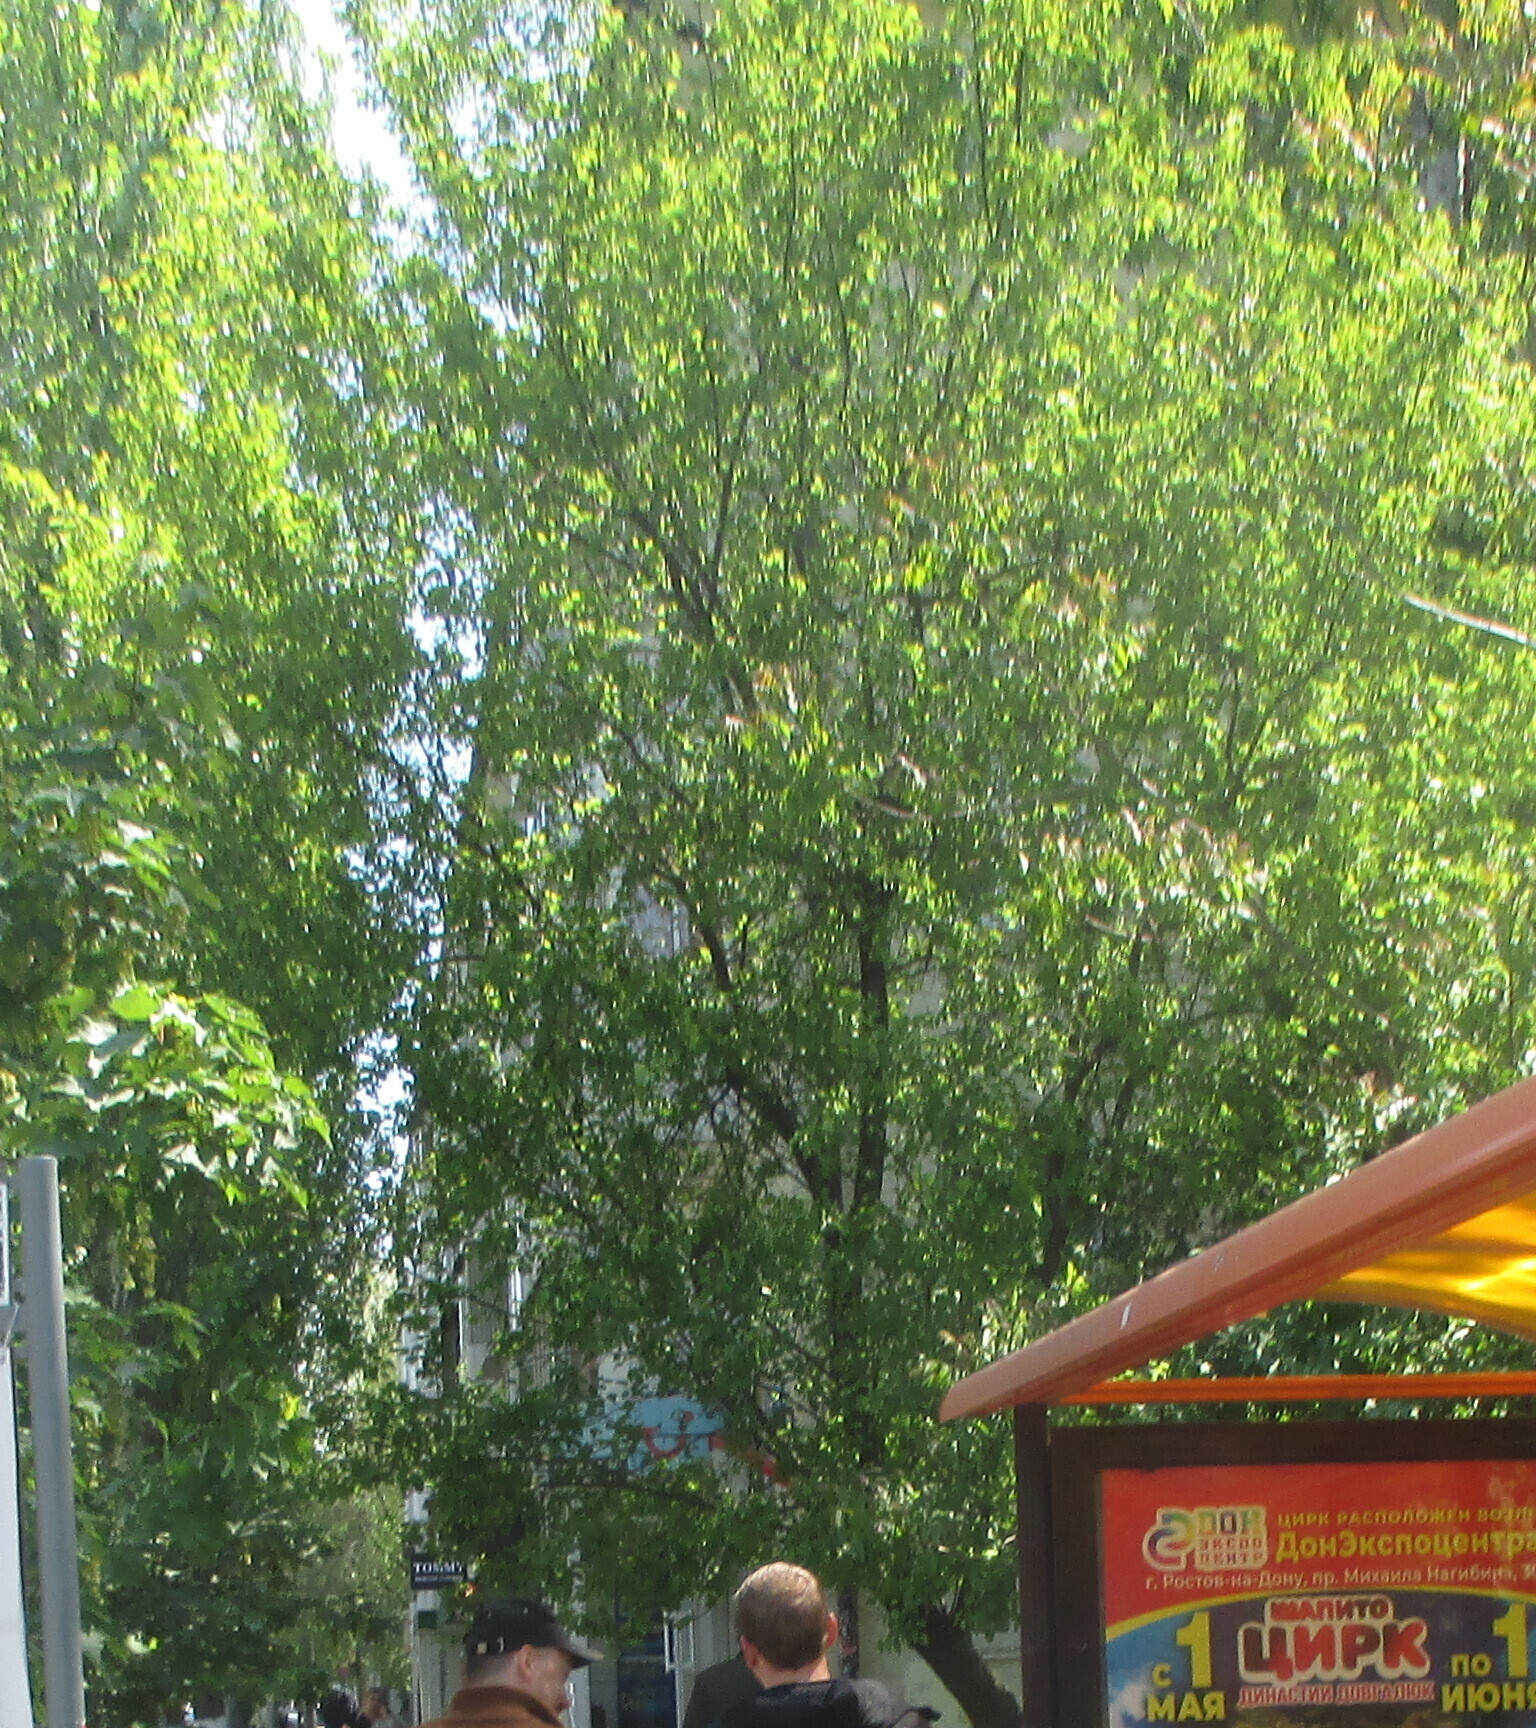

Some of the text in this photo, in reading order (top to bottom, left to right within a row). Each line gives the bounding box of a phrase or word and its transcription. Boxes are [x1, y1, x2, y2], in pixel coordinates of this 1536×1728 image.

[1277, 1510, 1331, 1528] ЦИРК
[1269, 1597, 1392, 1622] ШАПИТО
[1175, 1612, 1213, 1689] 1
[1239, 1619, 1429, 1684] ЦИРК
[1491, 1602, 1528, 1678] 1
[1146, 1690, 1227, 1722] МАЯ
